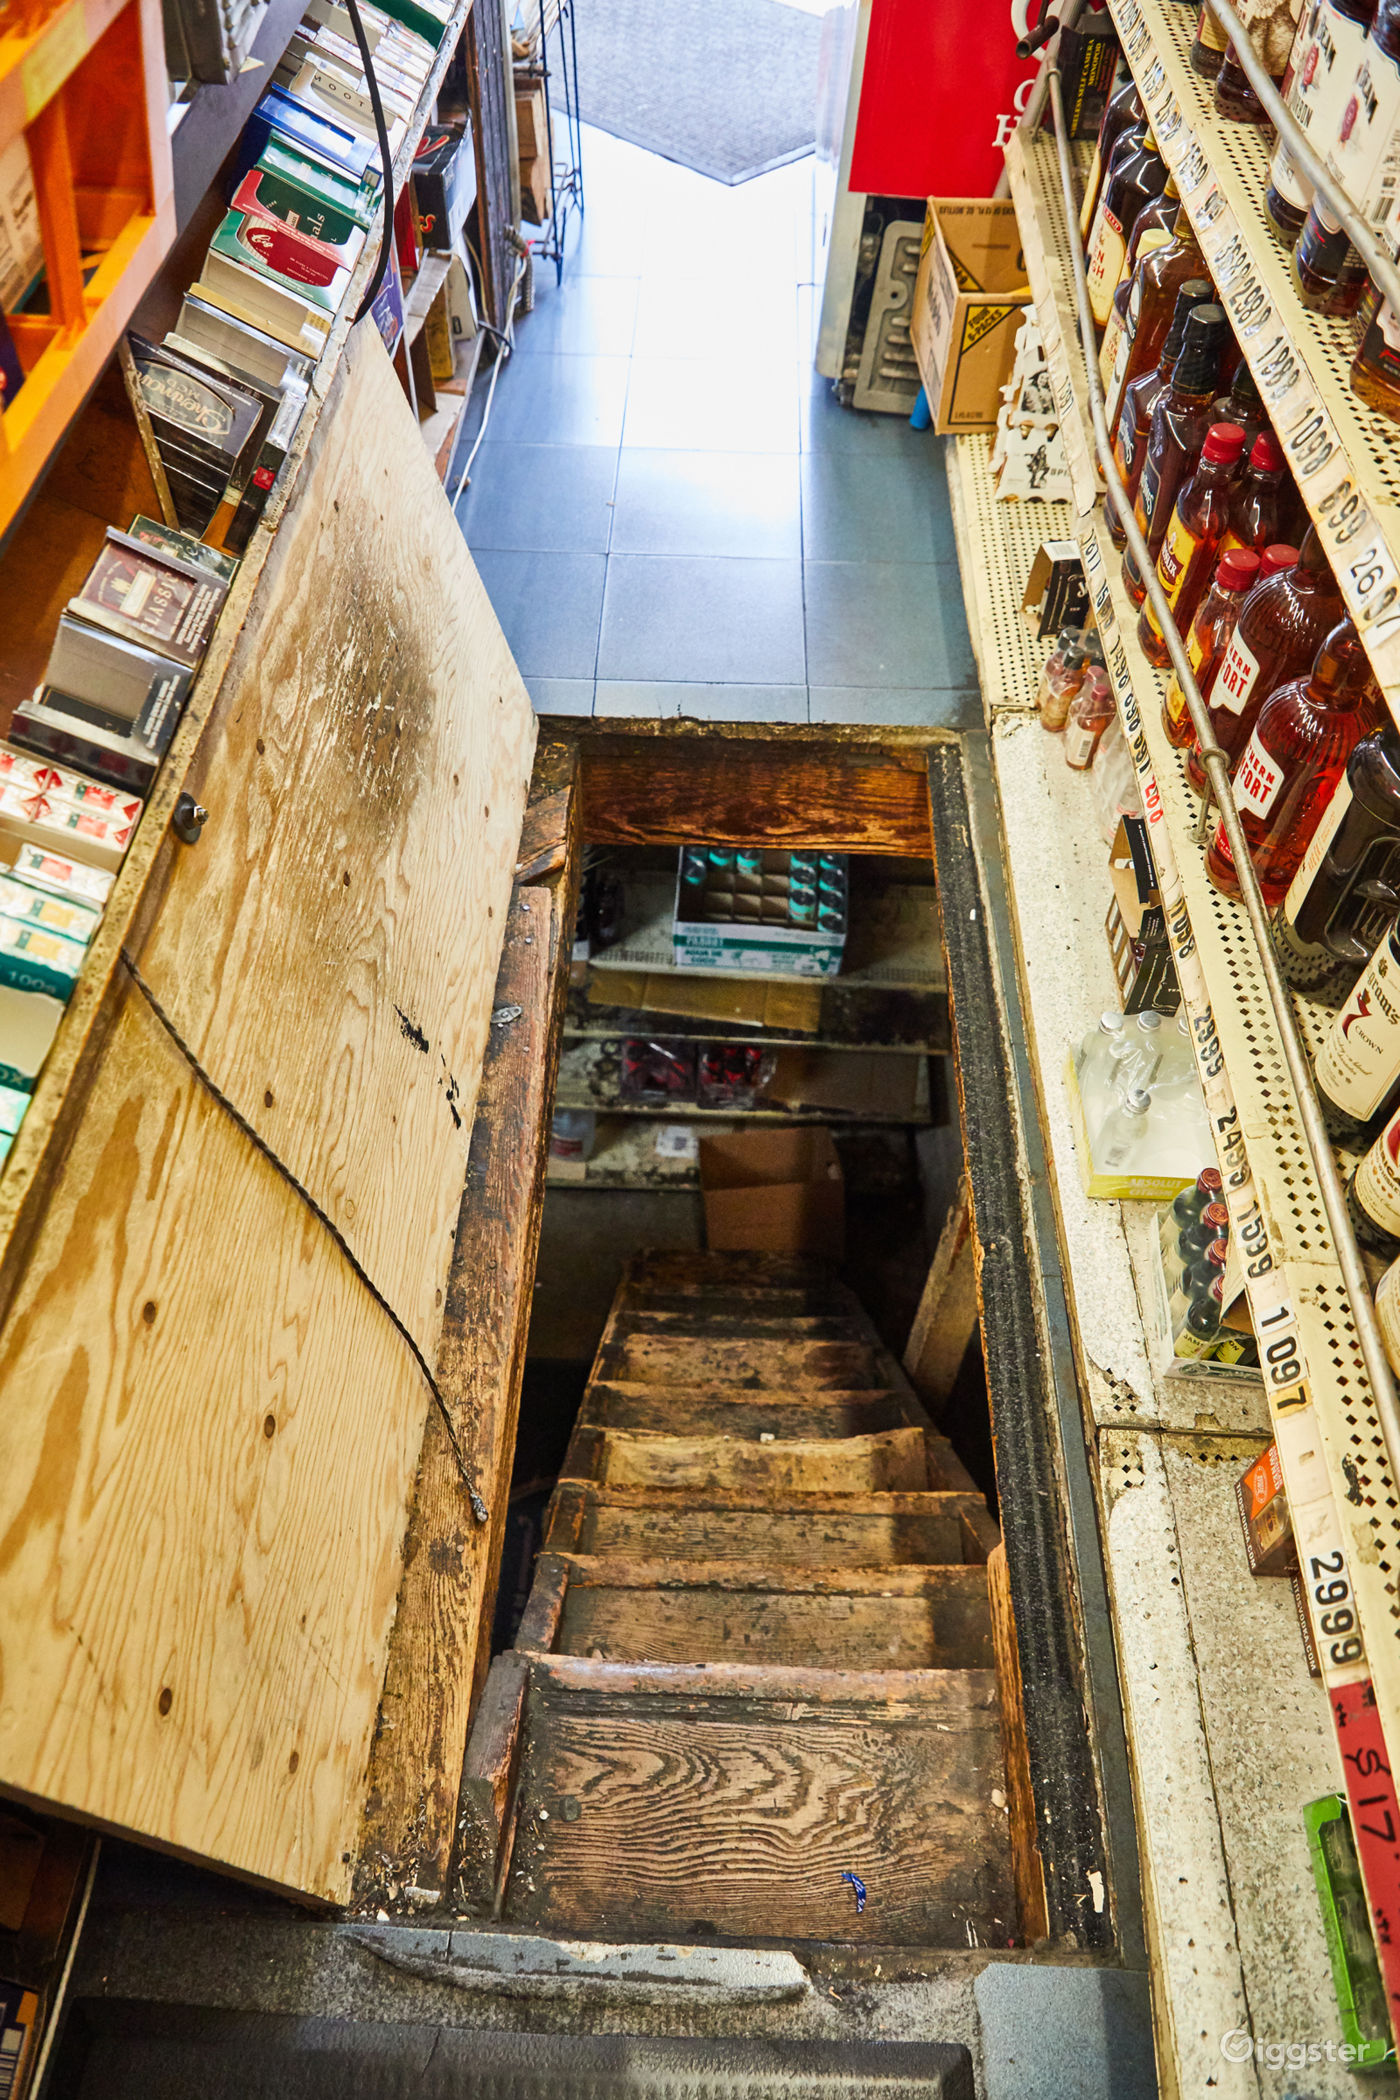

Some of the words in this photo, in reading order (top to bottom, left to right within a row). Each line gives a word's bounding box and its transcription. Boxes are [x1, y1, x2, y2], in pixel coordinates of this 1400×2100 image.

[1088, 43, 1101, 86] MONOPOD
[967, 307, 991, 329] FOUR
[1317, 480, 1367, 544] 699
[1355, 1025, 1383, 1055] CROWN
[1130, 1178, 1182, 1188] ABSOLUT
[1237, 1200, 1273, 1279] 1599
[1236, 1482, 1256, 1570] TITOSVODKA.COM
[1292, 1577, 1317, 1671] TITOSVODKA.COM
[1310, 1551, 1362, 1665] 2999
